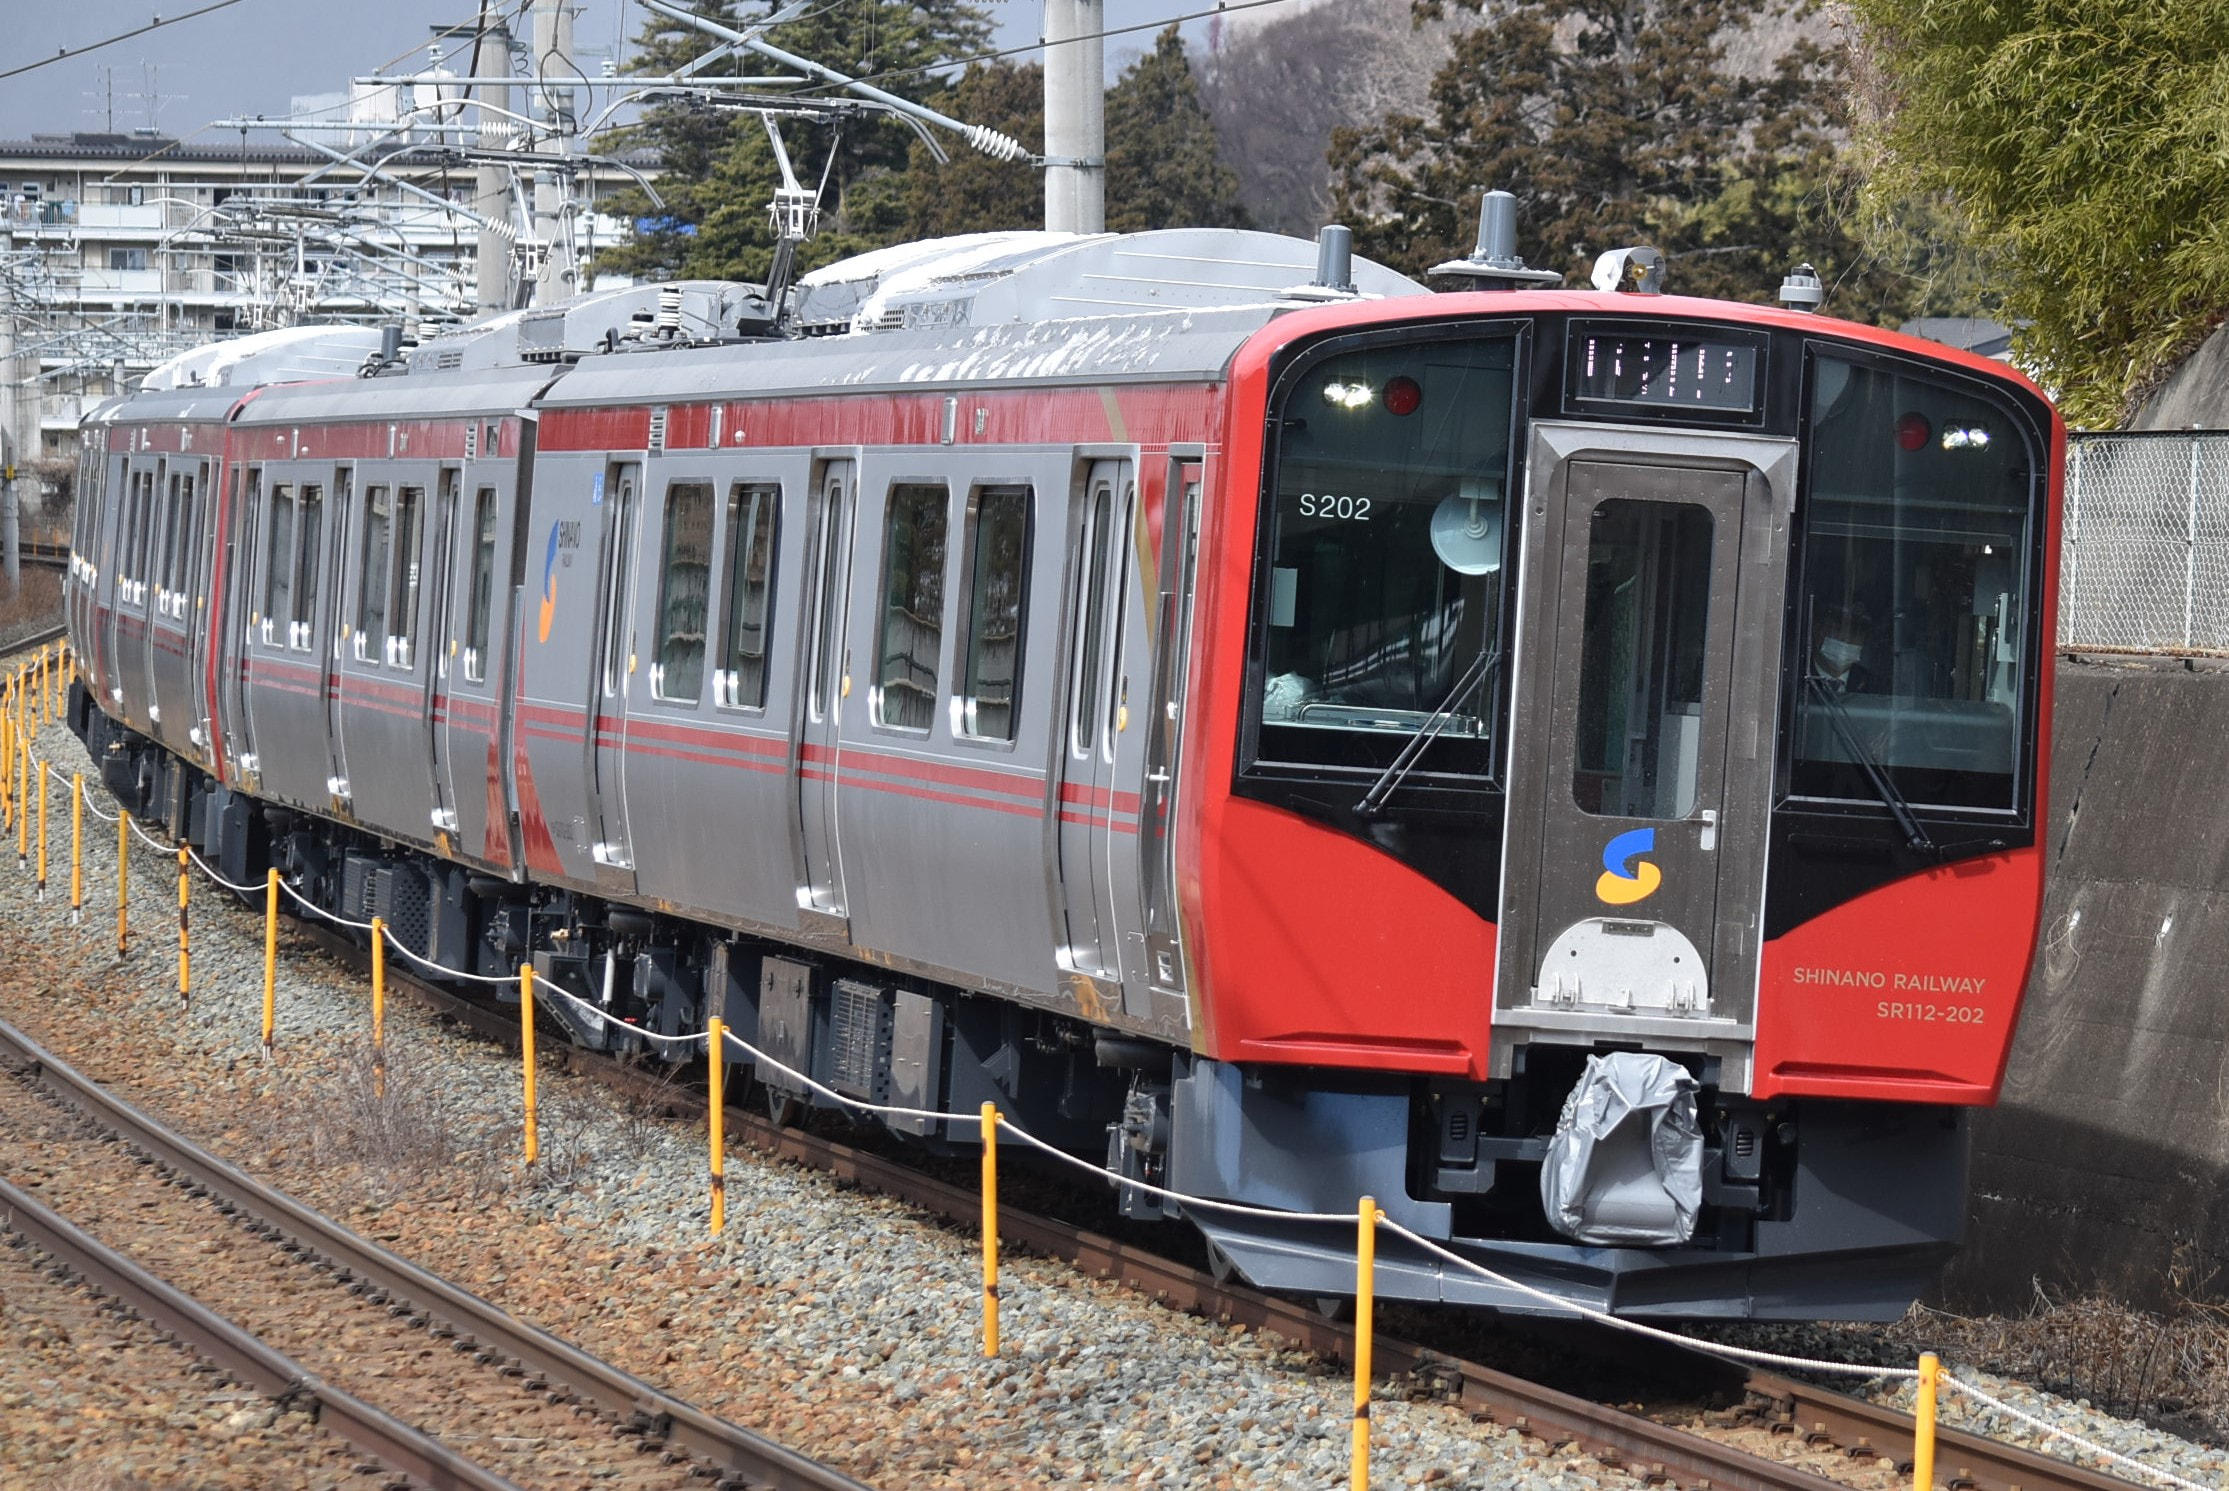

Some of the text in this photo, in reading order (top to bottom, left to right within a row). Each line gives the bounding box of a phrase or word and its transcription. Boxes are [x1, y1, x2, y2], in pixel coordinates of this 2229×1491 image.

[1299, 493, 1371, 520] S202
[1793, 967, 1985, 994] SHINANO RAILWAY
[1877, 1001, 1984, 1024] SR112-202
